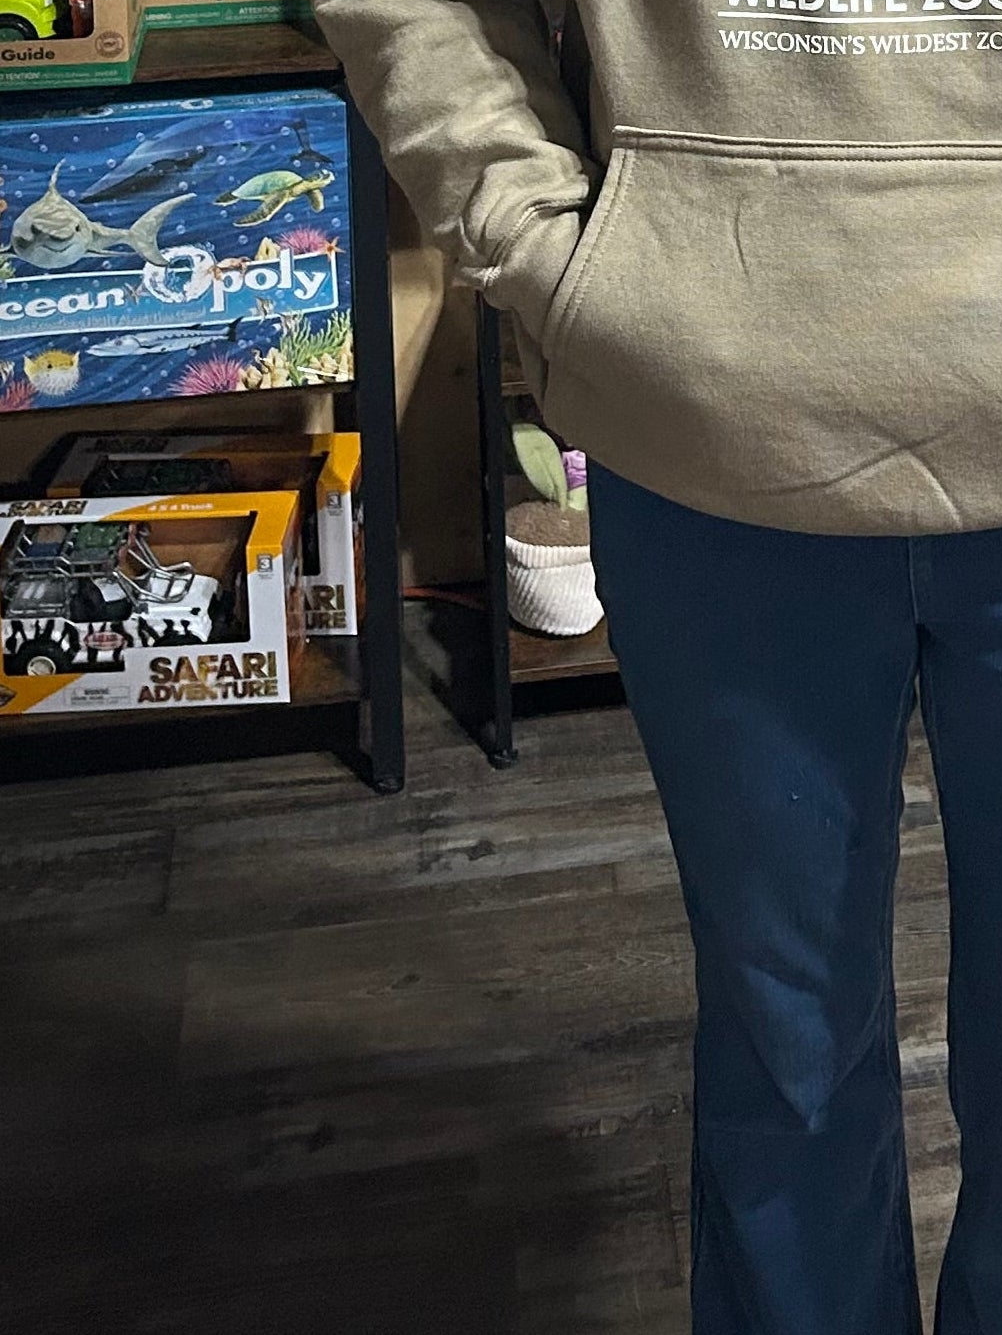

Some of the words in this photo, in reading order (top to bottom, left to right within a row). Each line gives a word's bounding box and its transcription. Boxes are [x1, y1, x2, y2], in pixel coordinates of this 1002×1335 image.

[1, 47, 55, 61] Guide
[718, 30, 866, 55] WISCONSIN'S
[873, 32, 972, 54] WILDEST
[0, 285, 124, 321] cean
[150, 651, 277, 684] SAFARI
[138, 680, 278, 703] ADVENTURE
